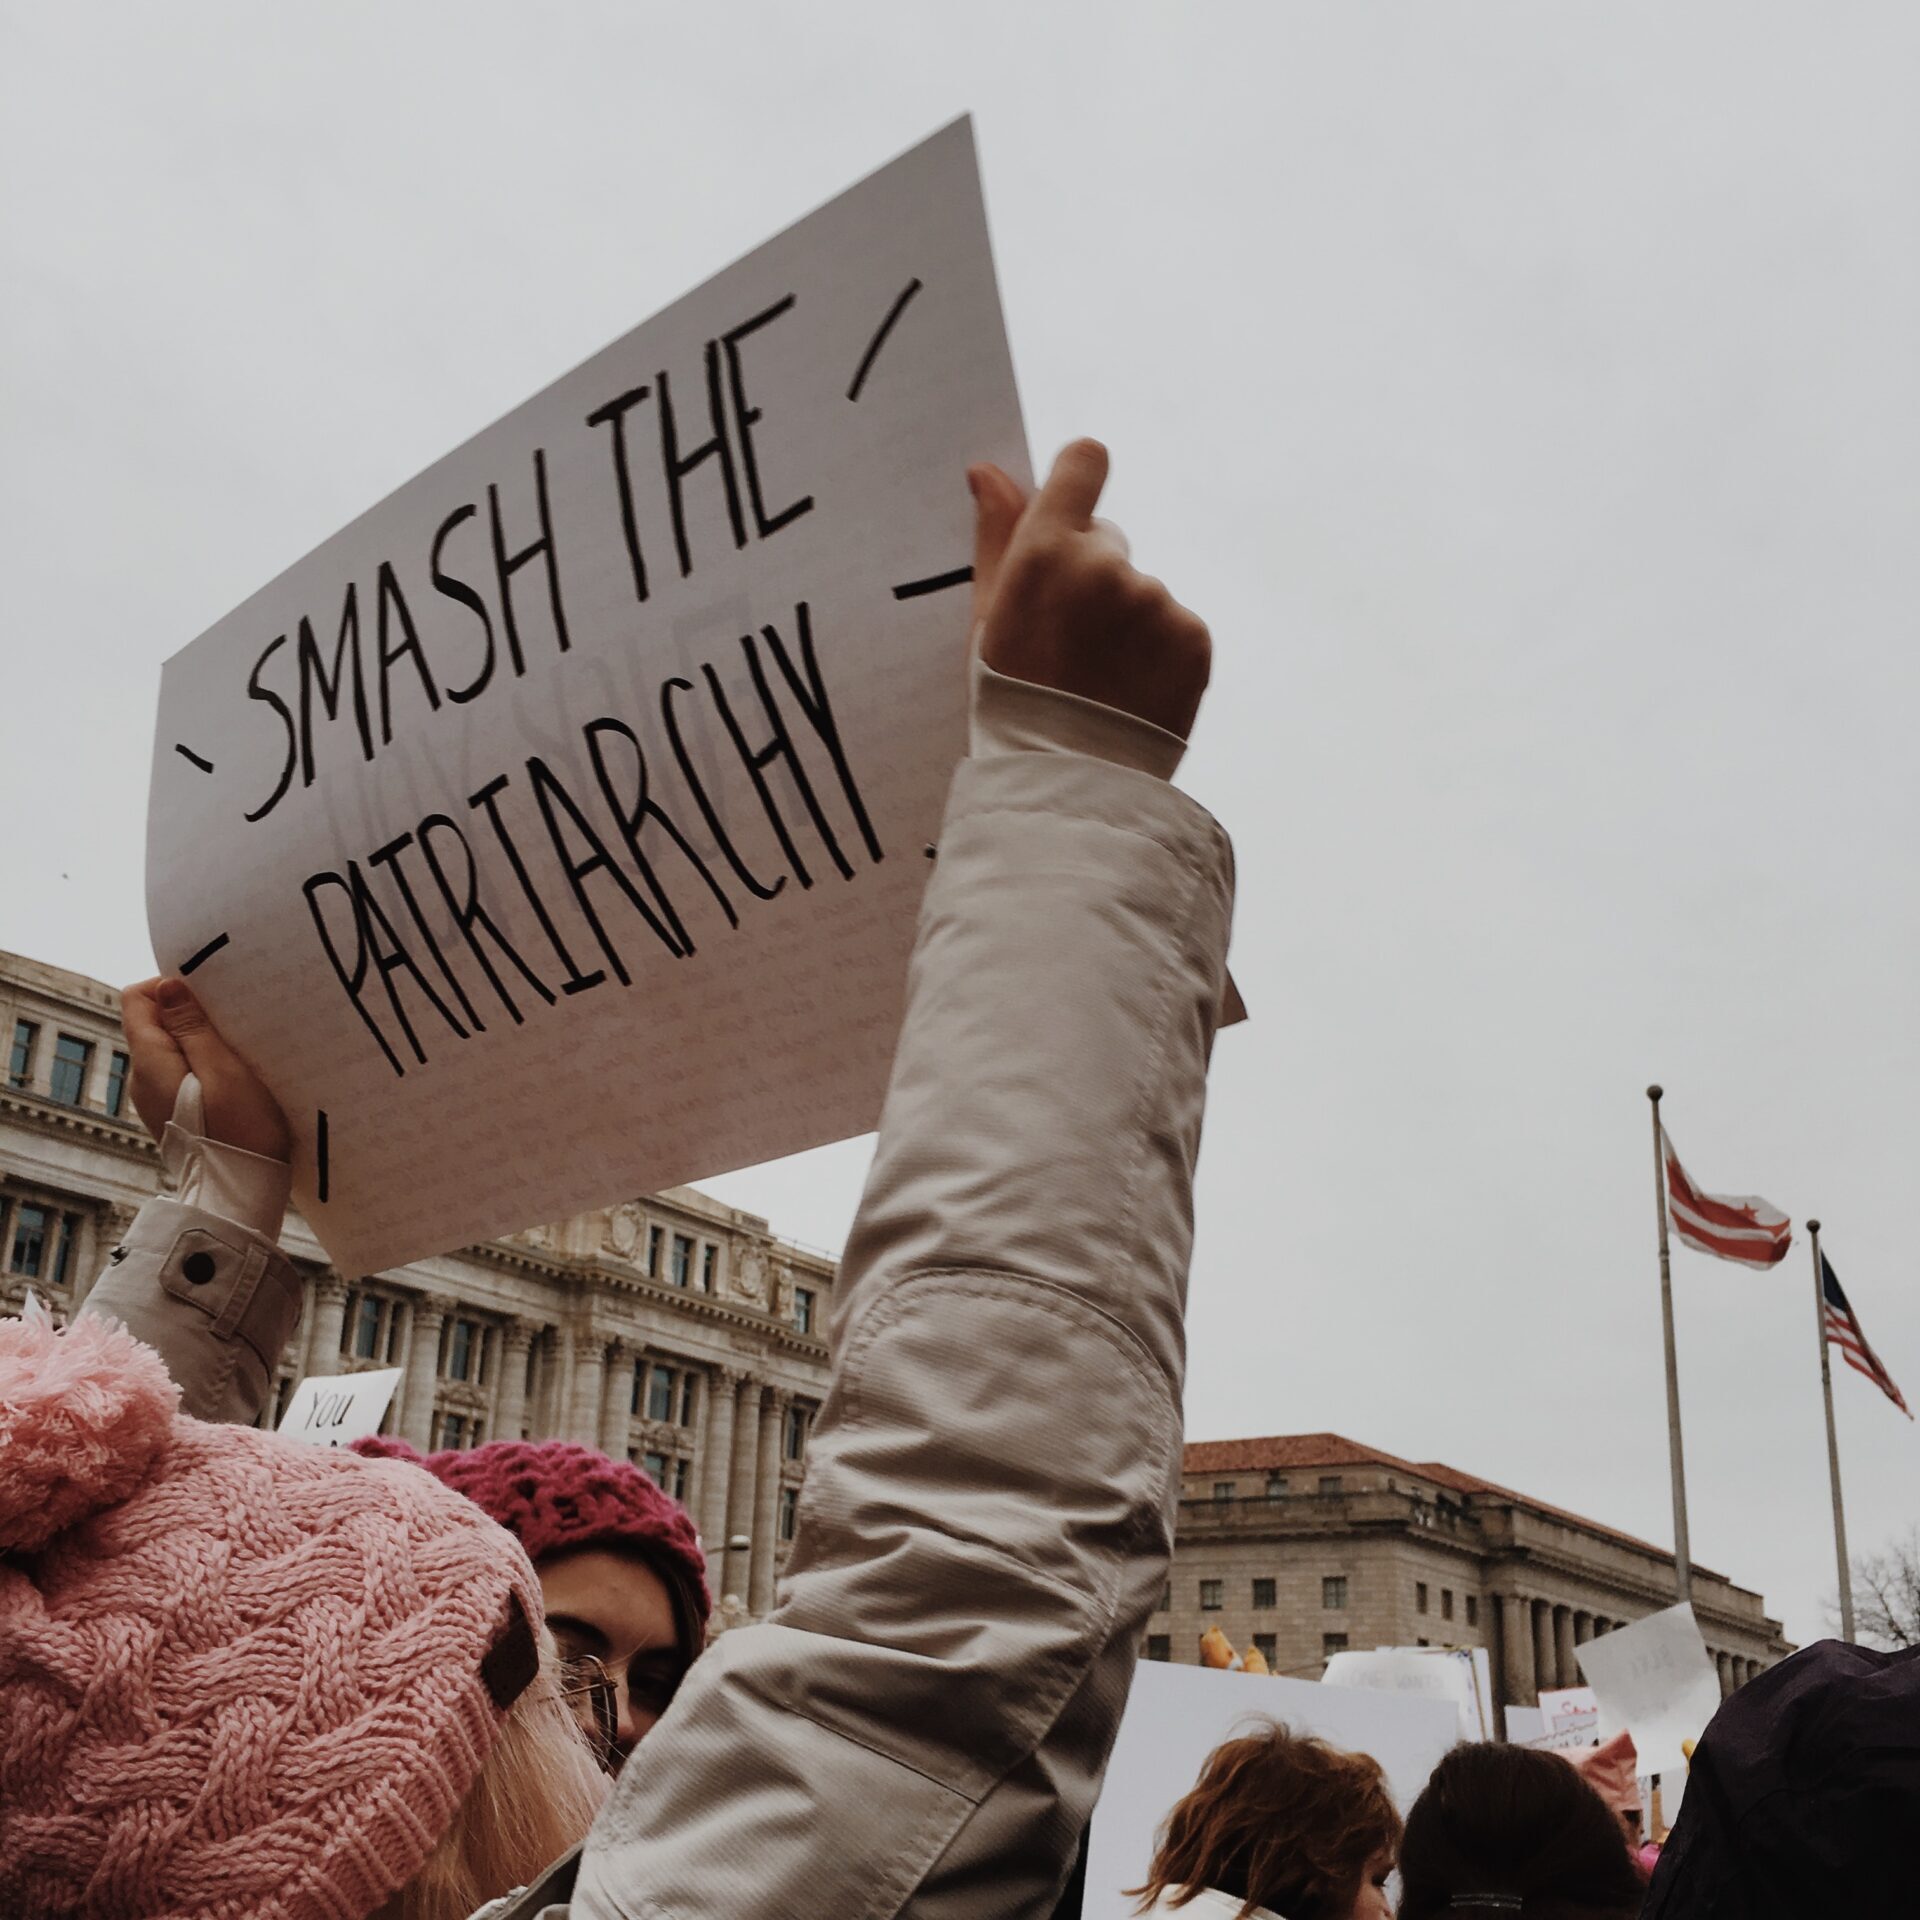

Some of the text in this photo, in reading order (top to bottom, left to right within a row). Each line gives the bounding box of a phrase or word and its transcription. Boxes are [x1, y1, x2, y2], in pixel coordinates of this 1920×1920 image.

[244, 295, 814, 823] SMASH THE
[301, 601, 885, 1078] PATRIARCHY
